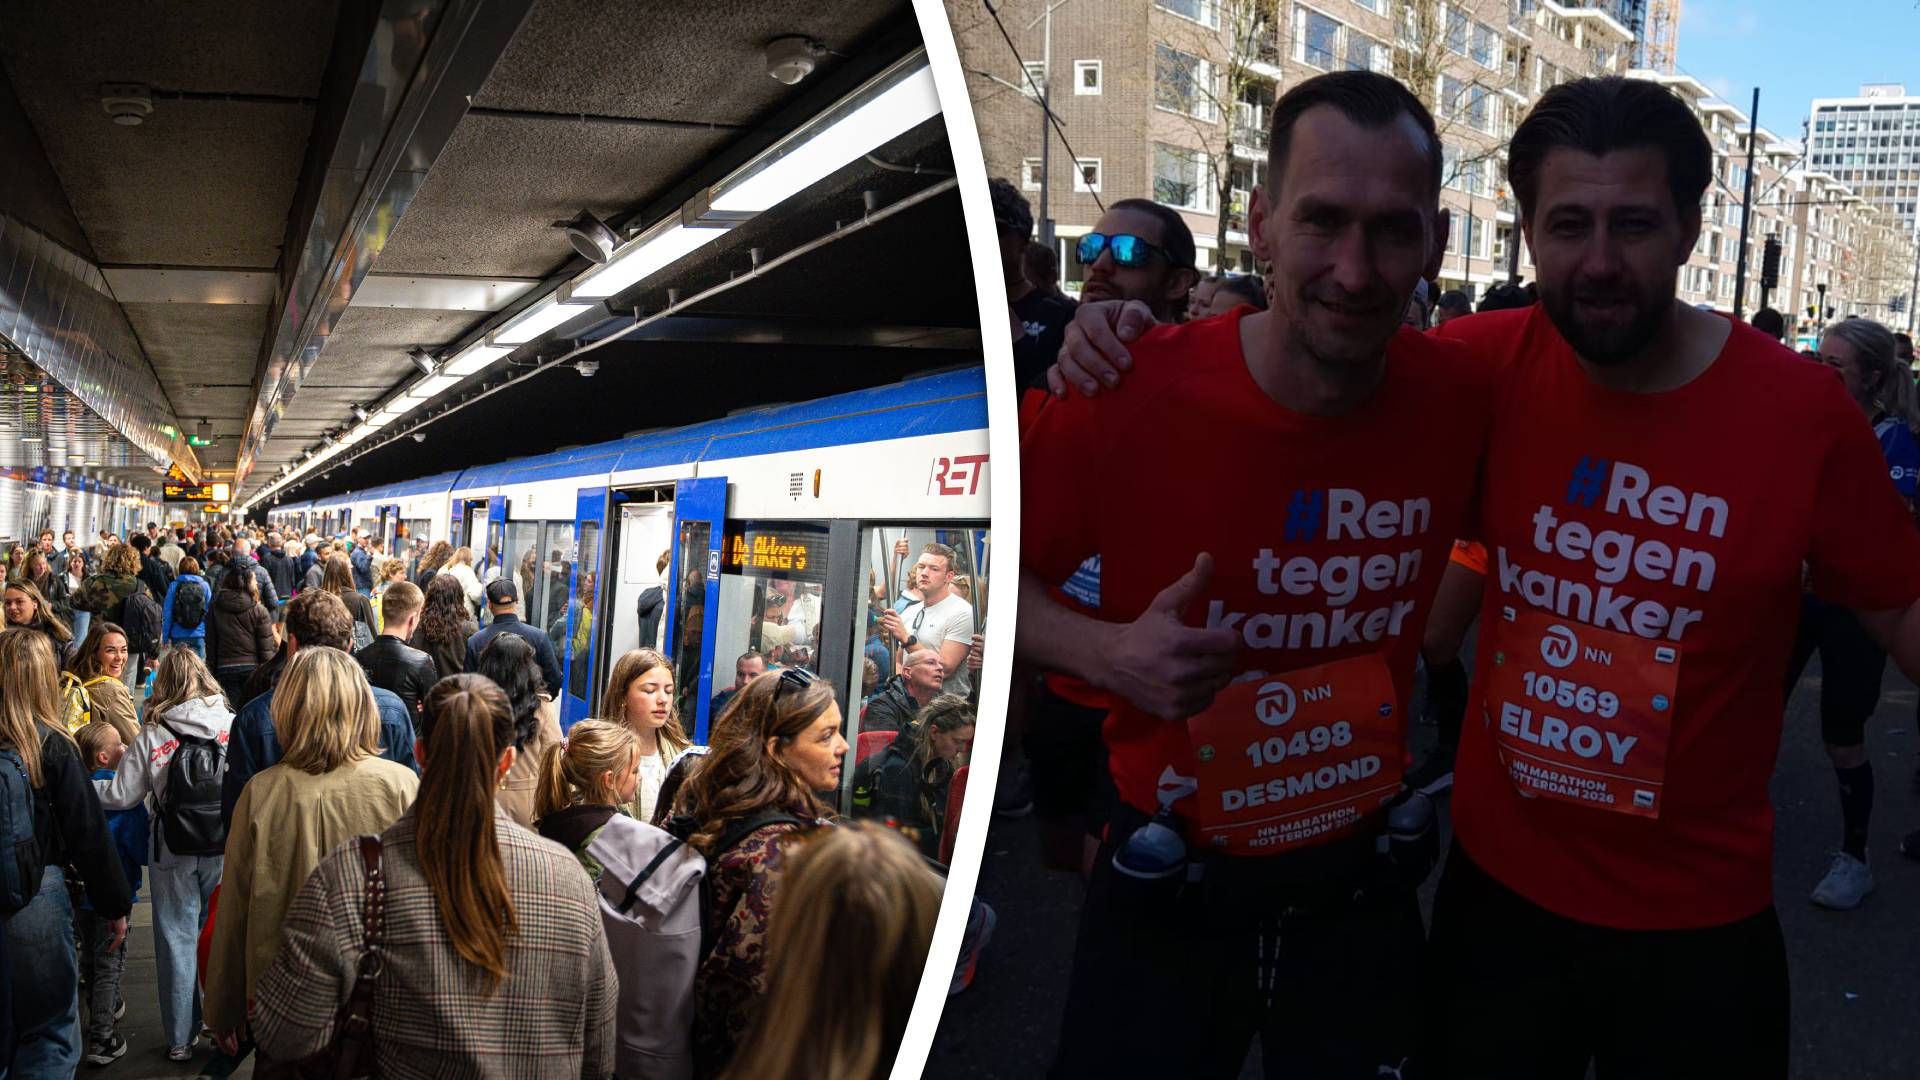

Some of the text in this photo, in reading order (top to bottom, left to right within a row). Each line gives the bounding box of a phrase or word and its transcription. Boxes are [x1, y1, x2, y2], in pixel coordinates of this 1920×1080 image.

[936, 453, 991, 496] RET
[1567, 454, 1729, 539] #Ren
[1284, 487, 1432, 542] #Ren
[733, 535, 750, 566] De
[752, 536, 807, 570] Akkers
[1532, 504, 1718, 592] tegen
[1252, 548, 1423, 607] tegen
[1496, 545, 1704, 643] kanker
[1206, 599, 1416, 650] kanker
[1584, 646, 1613, 667] NN
[1302, 684, 1332, 704] NN
[1523, 671, 1620, 720] 10569
[1246, 720, 1353, 769] 10498
[1500, 701, 1639, 765] ELROY
[1220, 754, 1382, 813] DESMOND
[1529, 765, 1608, 792] MARATHON
[1248, 822, 1334, 848] ROTTERDAM
[1257, 806, 1357, 839] NN MARATHON
